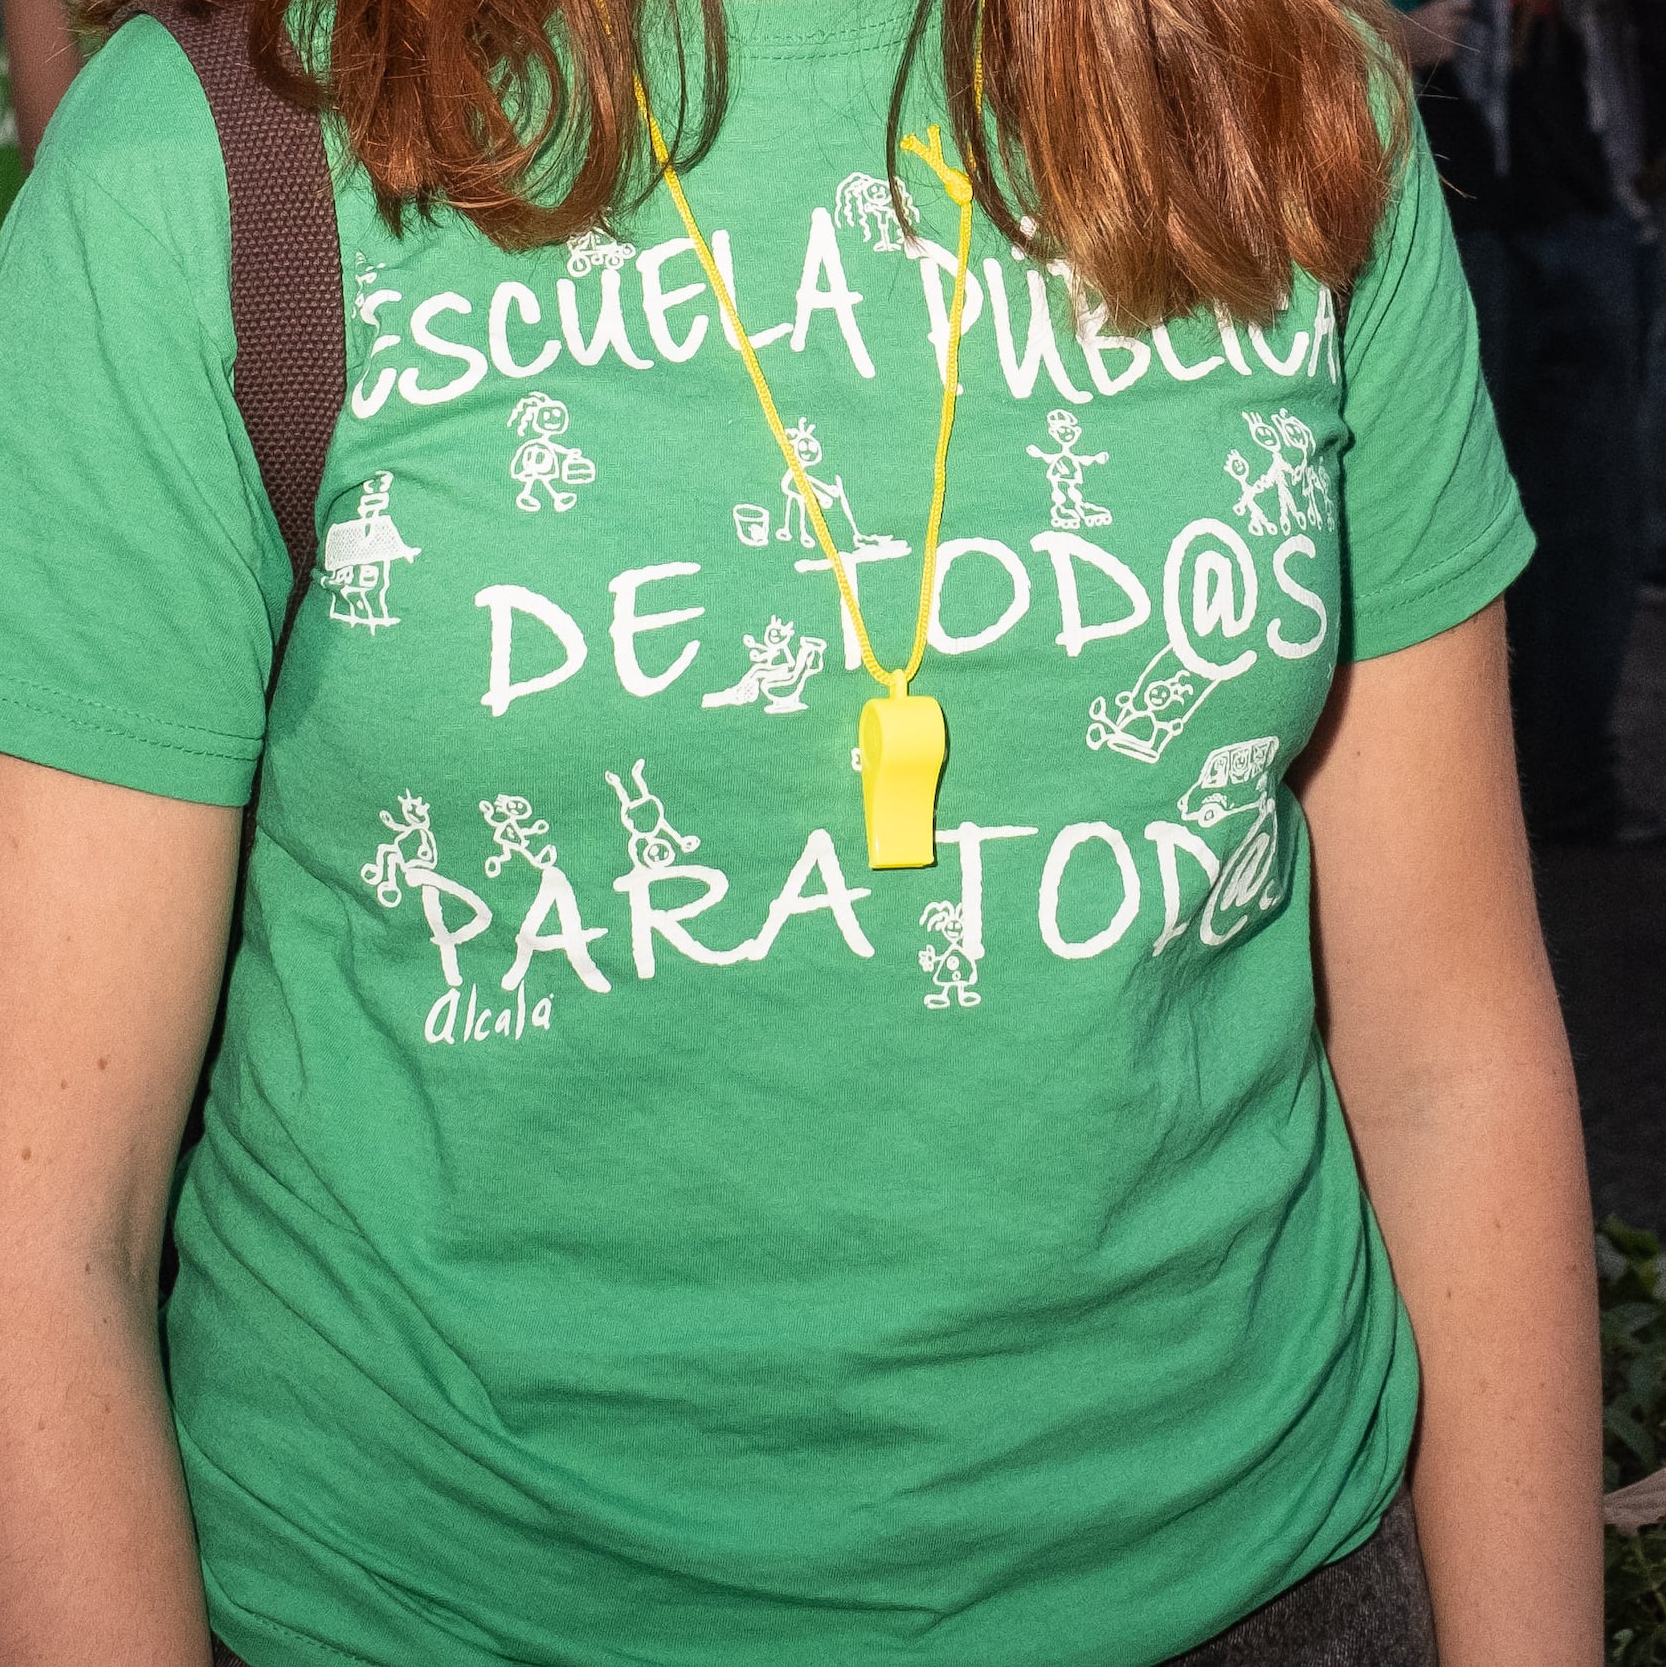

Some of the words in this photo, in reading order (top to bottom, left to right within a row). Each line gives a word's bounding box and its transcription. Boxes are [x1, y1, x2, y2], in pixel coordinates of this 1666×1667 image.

[351, 205, 876, 419] ESCUELA
[473, 562, 706, 717] DE
[794, 517, 1328, 681] TOD@S
[405, 828, 876, 994] PARA
